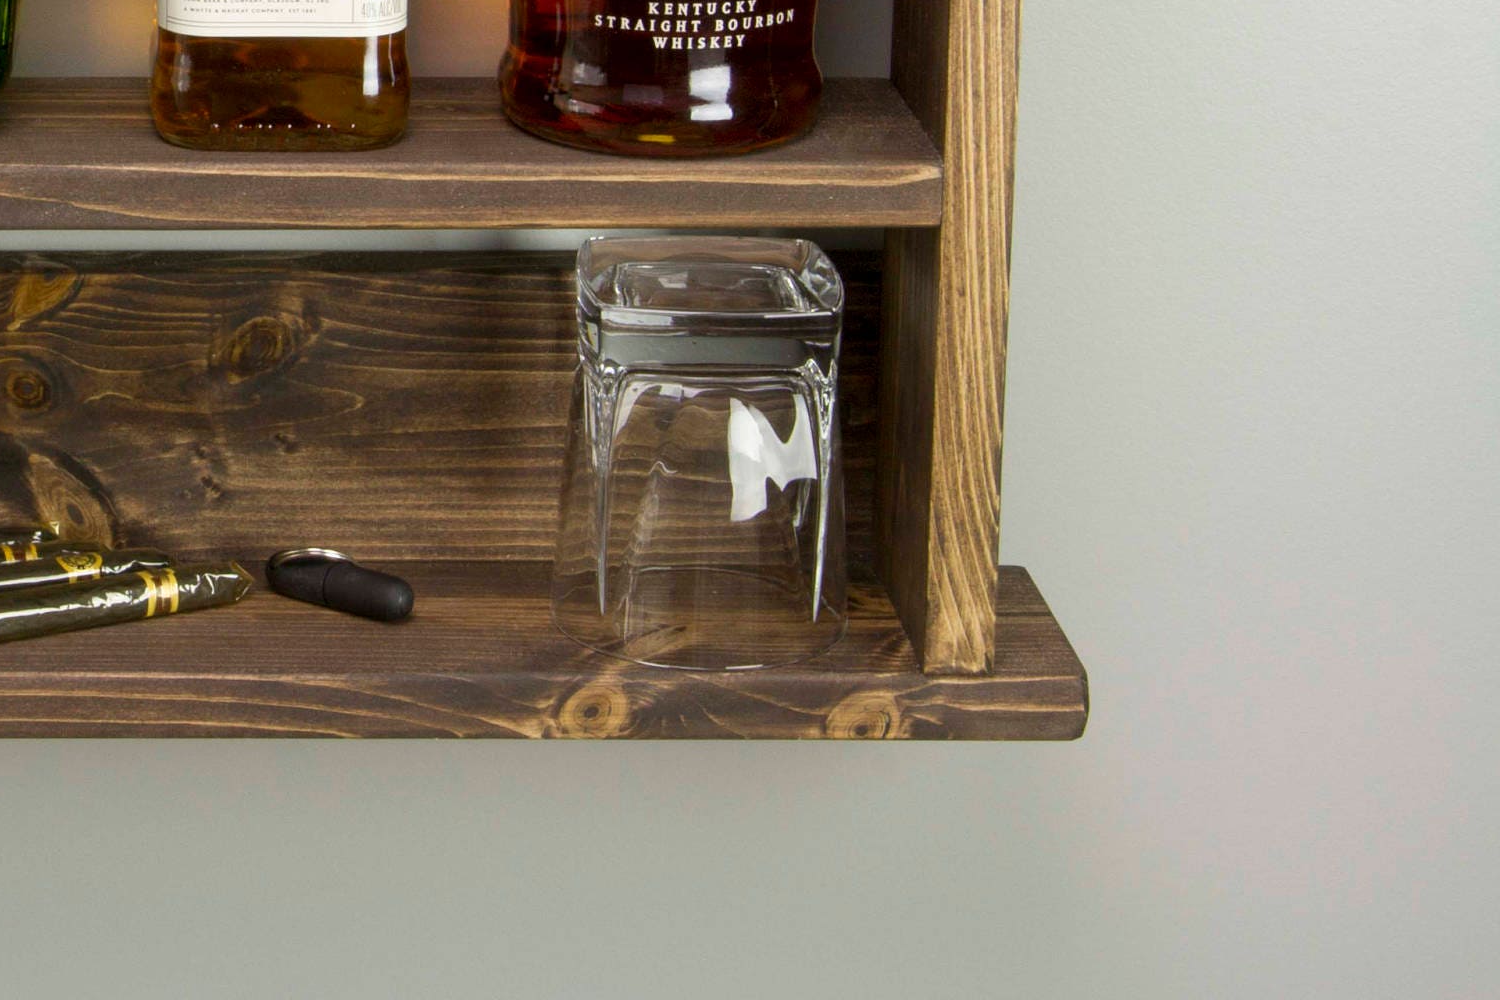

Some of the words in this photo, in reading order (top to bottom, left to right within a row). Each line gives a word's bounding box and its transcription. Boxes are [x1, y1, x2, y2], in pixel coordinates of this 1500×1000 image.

[648, 0, 758, 16] KENTUCKY
[594, 14, 701, 32] STRAIGHT
[715, 8, 795, 32] BOURBON
[653, 34, 746, 49] WHISKEY
